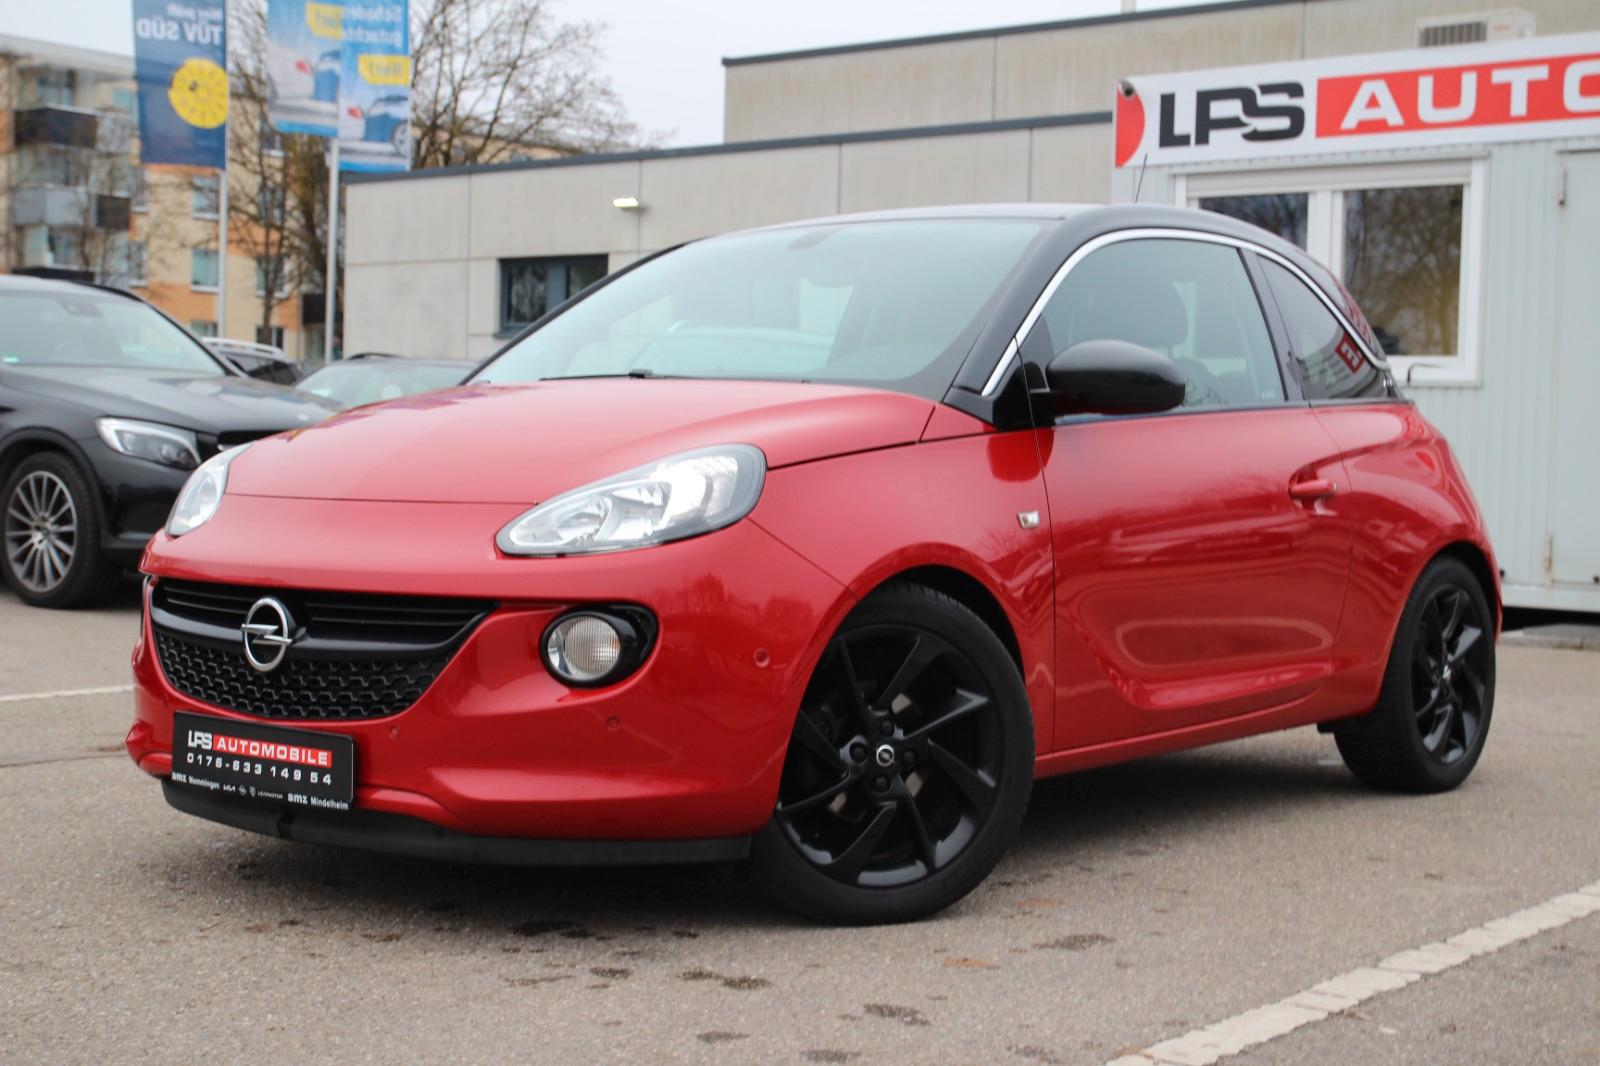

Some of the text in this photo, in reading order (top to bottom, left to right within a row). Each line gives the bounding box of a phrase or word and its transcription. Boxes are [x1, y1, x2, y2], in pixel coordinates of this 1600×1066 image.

[1158, 81, 1306, 148] LPS
[187, 729, 329, 767] LPS AUTOMOBILE
[171, 771, 187, 783] amz
[287, 792, 308, 805] amz
[310, 796, 349, 811] Mindelheim
[309, 772, 332, 786] 54
